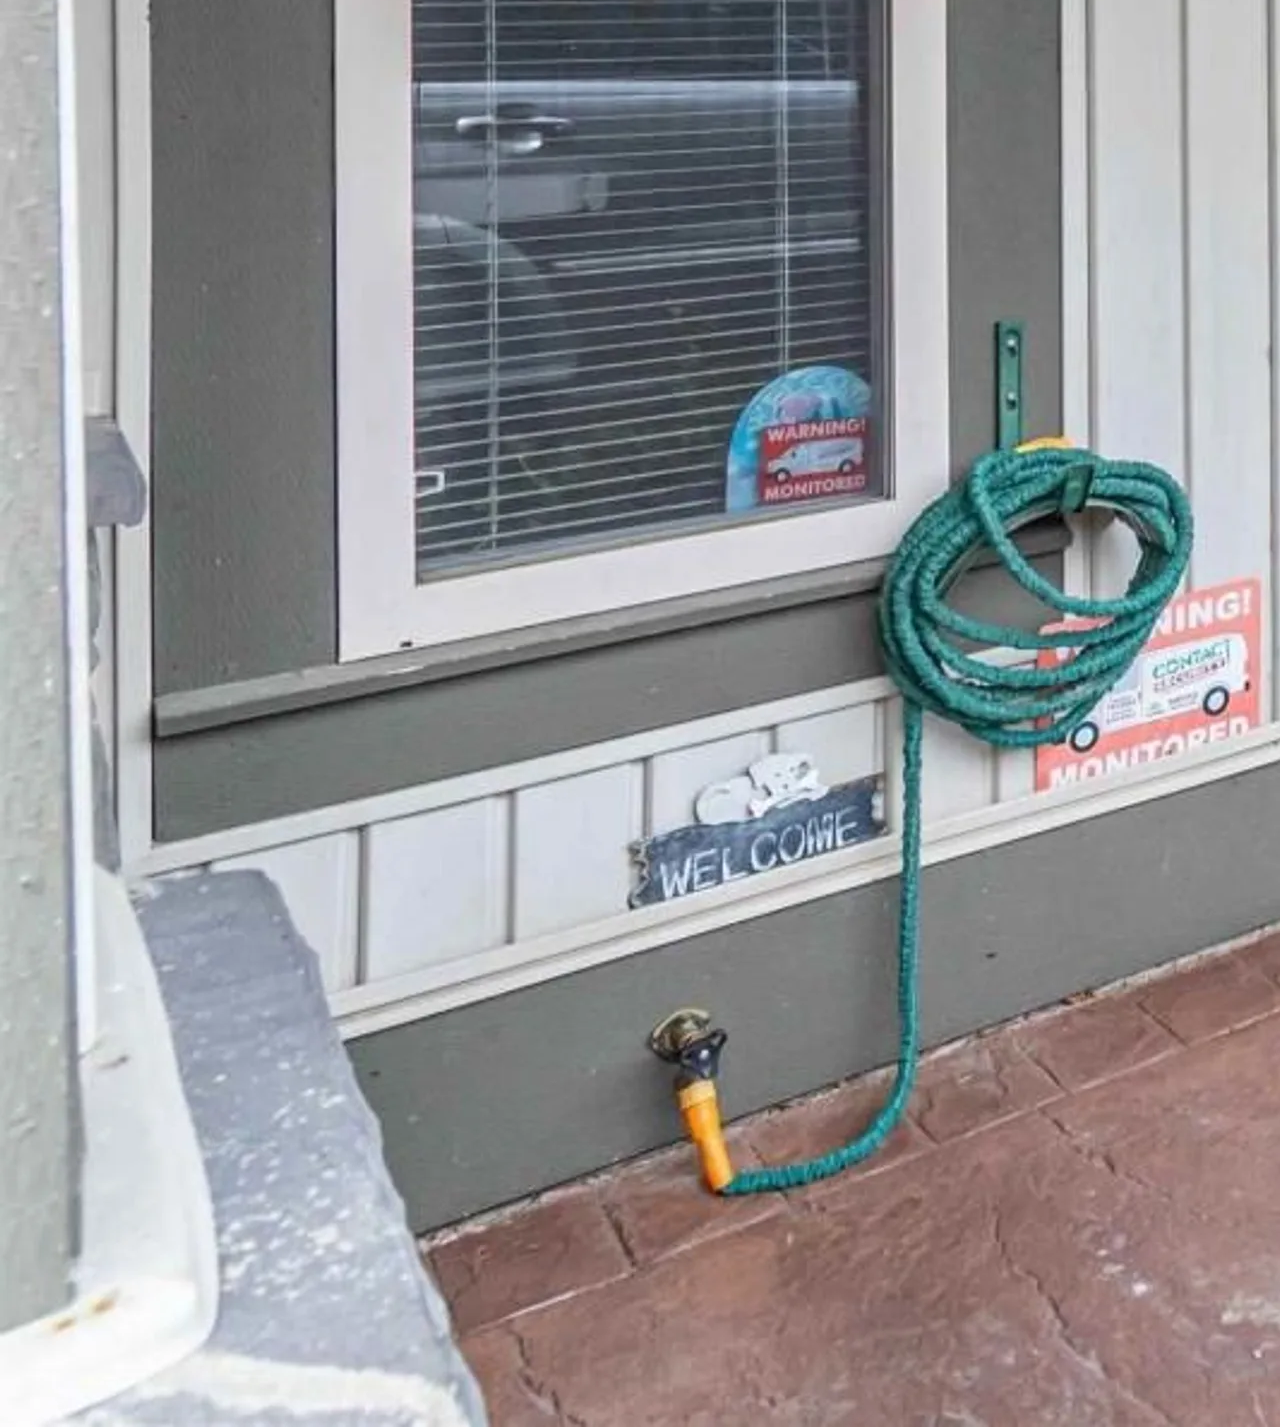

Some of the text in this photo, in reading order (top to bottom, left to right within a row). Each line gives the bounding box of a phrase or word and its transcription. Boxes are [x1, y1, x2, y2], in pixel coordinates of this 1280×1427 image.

[767, 418, 865, 443] WARNING!
[764, 474, 865, 502] MONITORED
[1153, 587, 1252, 637] NING!
[1047, 716, 1251, 789] MONITORED
[659, 805, 858, 900] WELCOME
